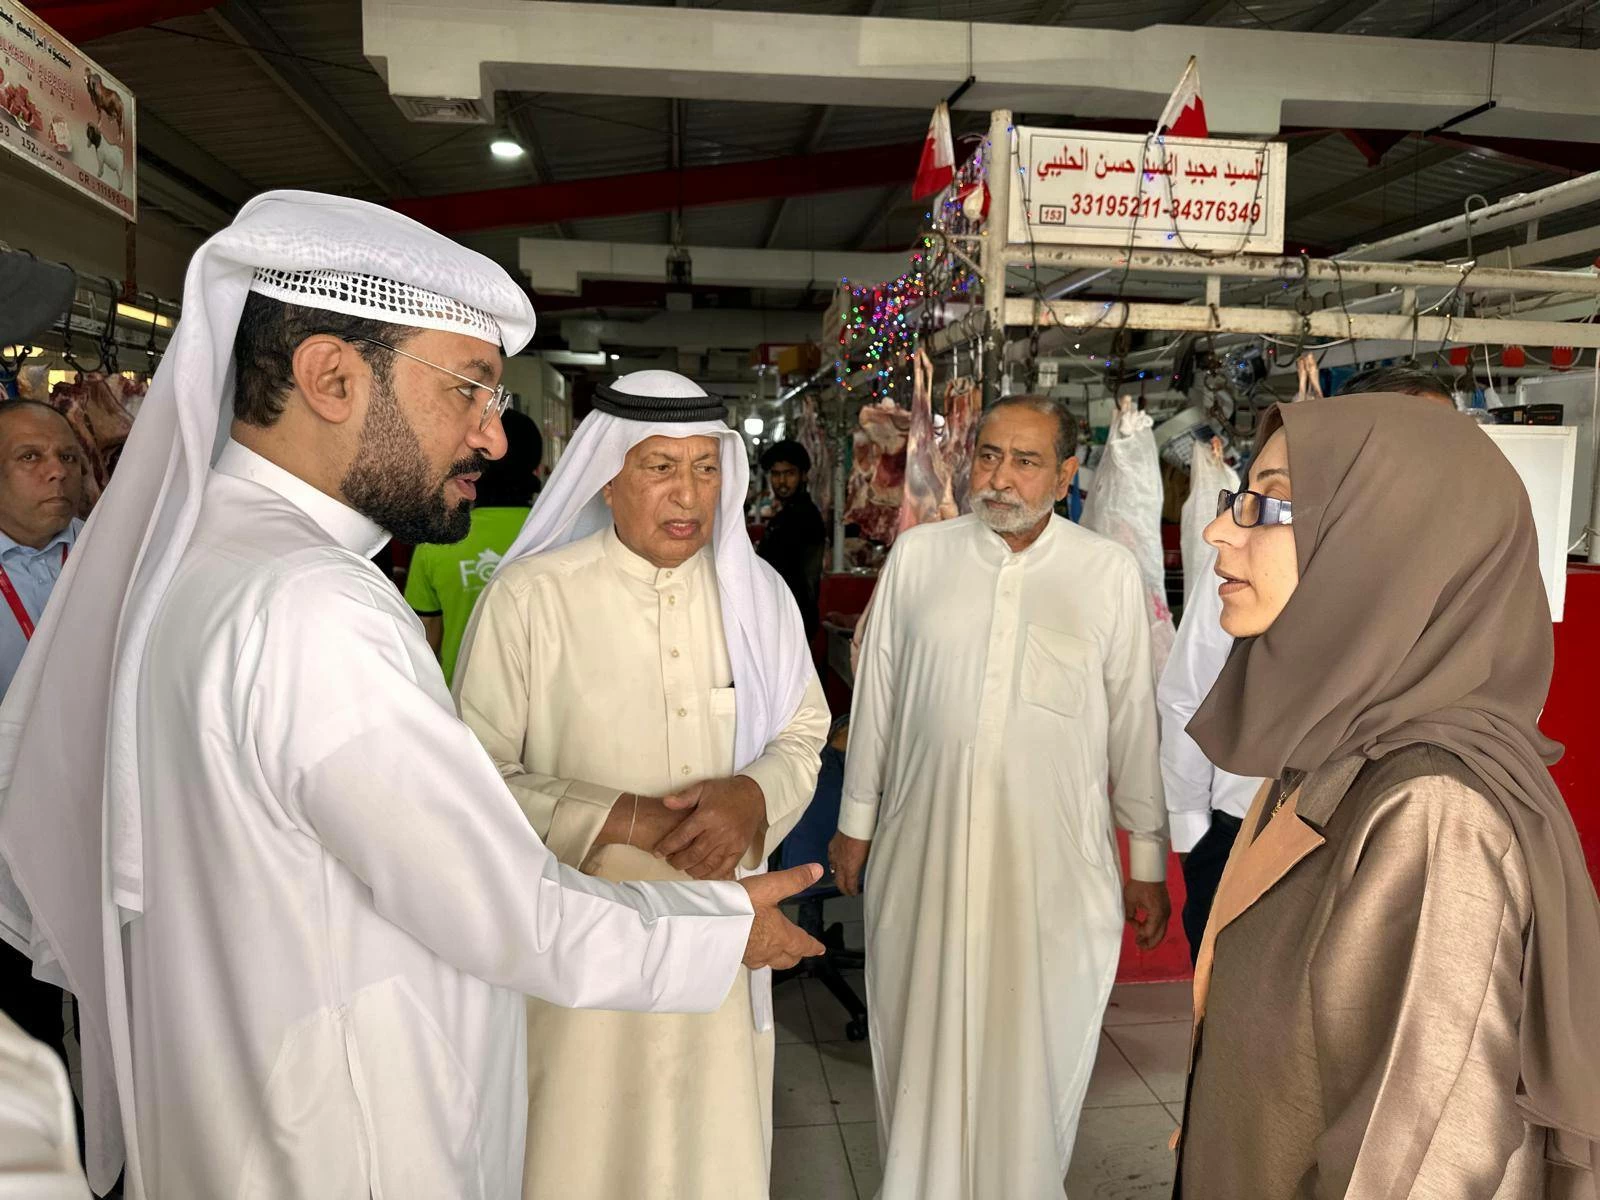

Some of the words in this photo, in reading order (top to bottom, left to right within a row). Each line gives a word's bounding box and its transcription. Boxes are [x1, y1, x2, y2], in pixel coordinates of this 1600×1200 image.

[1037, 144, 1088, 181] الحليبي
[1095, 153, 1135, 179] حسن
[1143, 151, 1178, 182] السيد
[1184, 160, 1217, 185] مجيد
[1044, 209, 1062, 221] 153
[1070, 193, 1261, 223] 33195211-34376349
